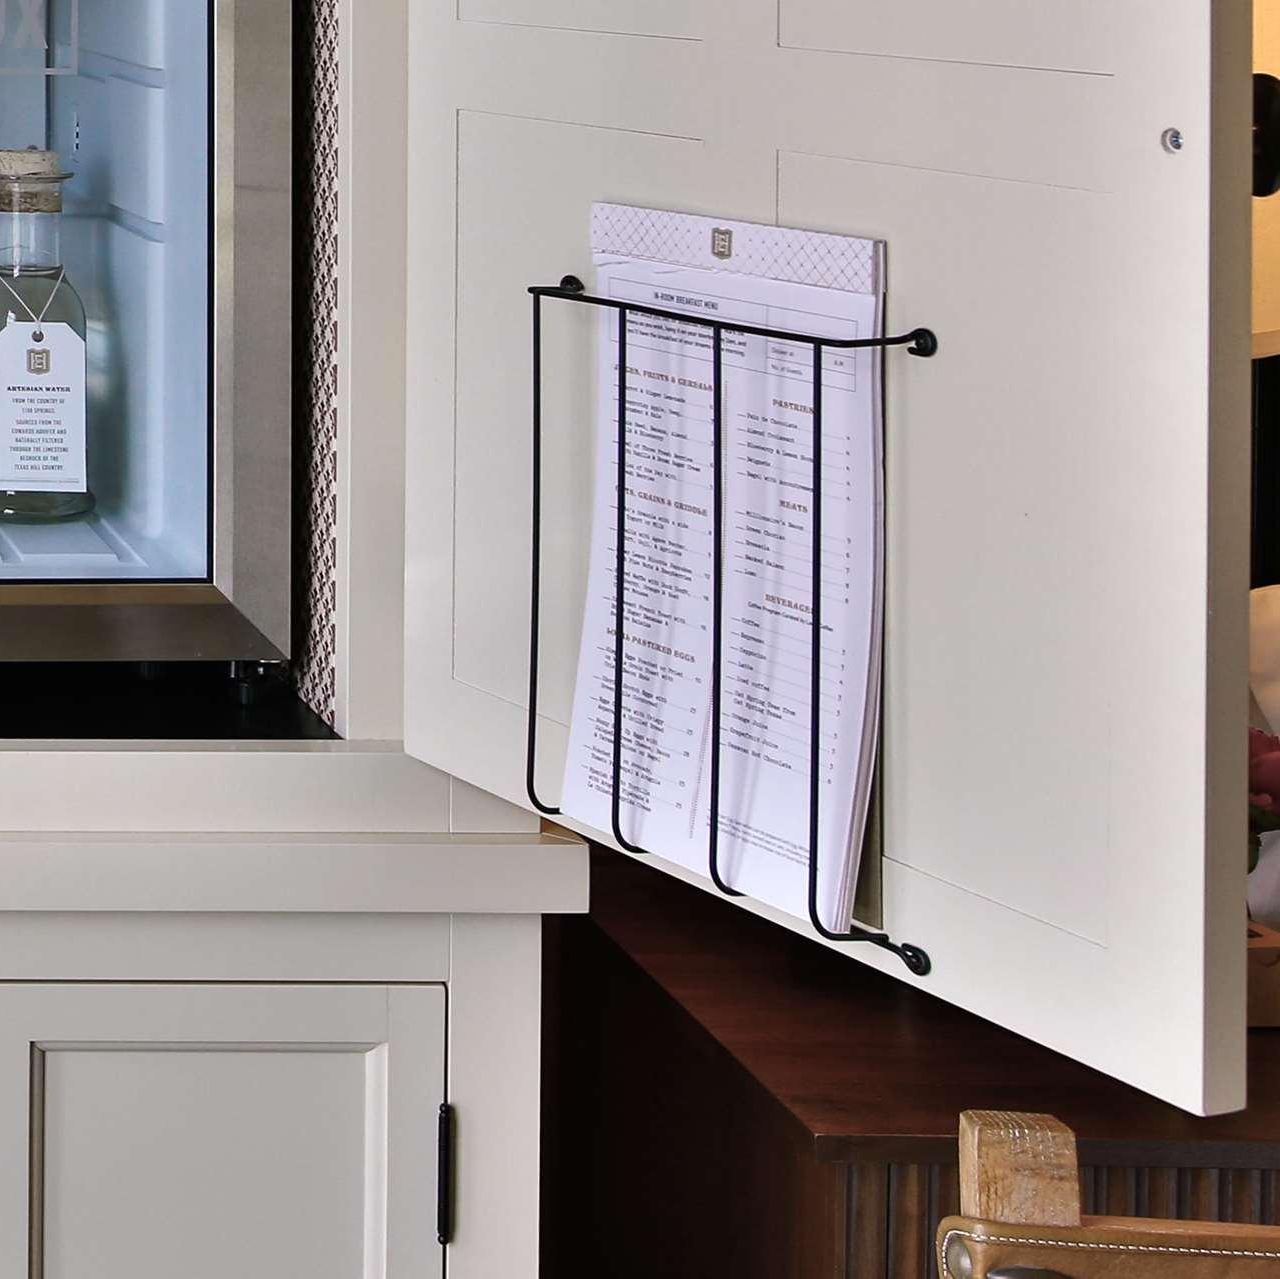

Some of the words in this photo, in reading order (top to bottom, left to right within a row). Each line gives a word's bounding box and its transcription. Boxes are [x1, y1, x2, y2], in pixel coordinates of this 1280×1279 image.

[779, 499, 809, 514] MEATS
[631, 637, 673, 655] PASTURED
[673, 649, 696, 664] EGGS
